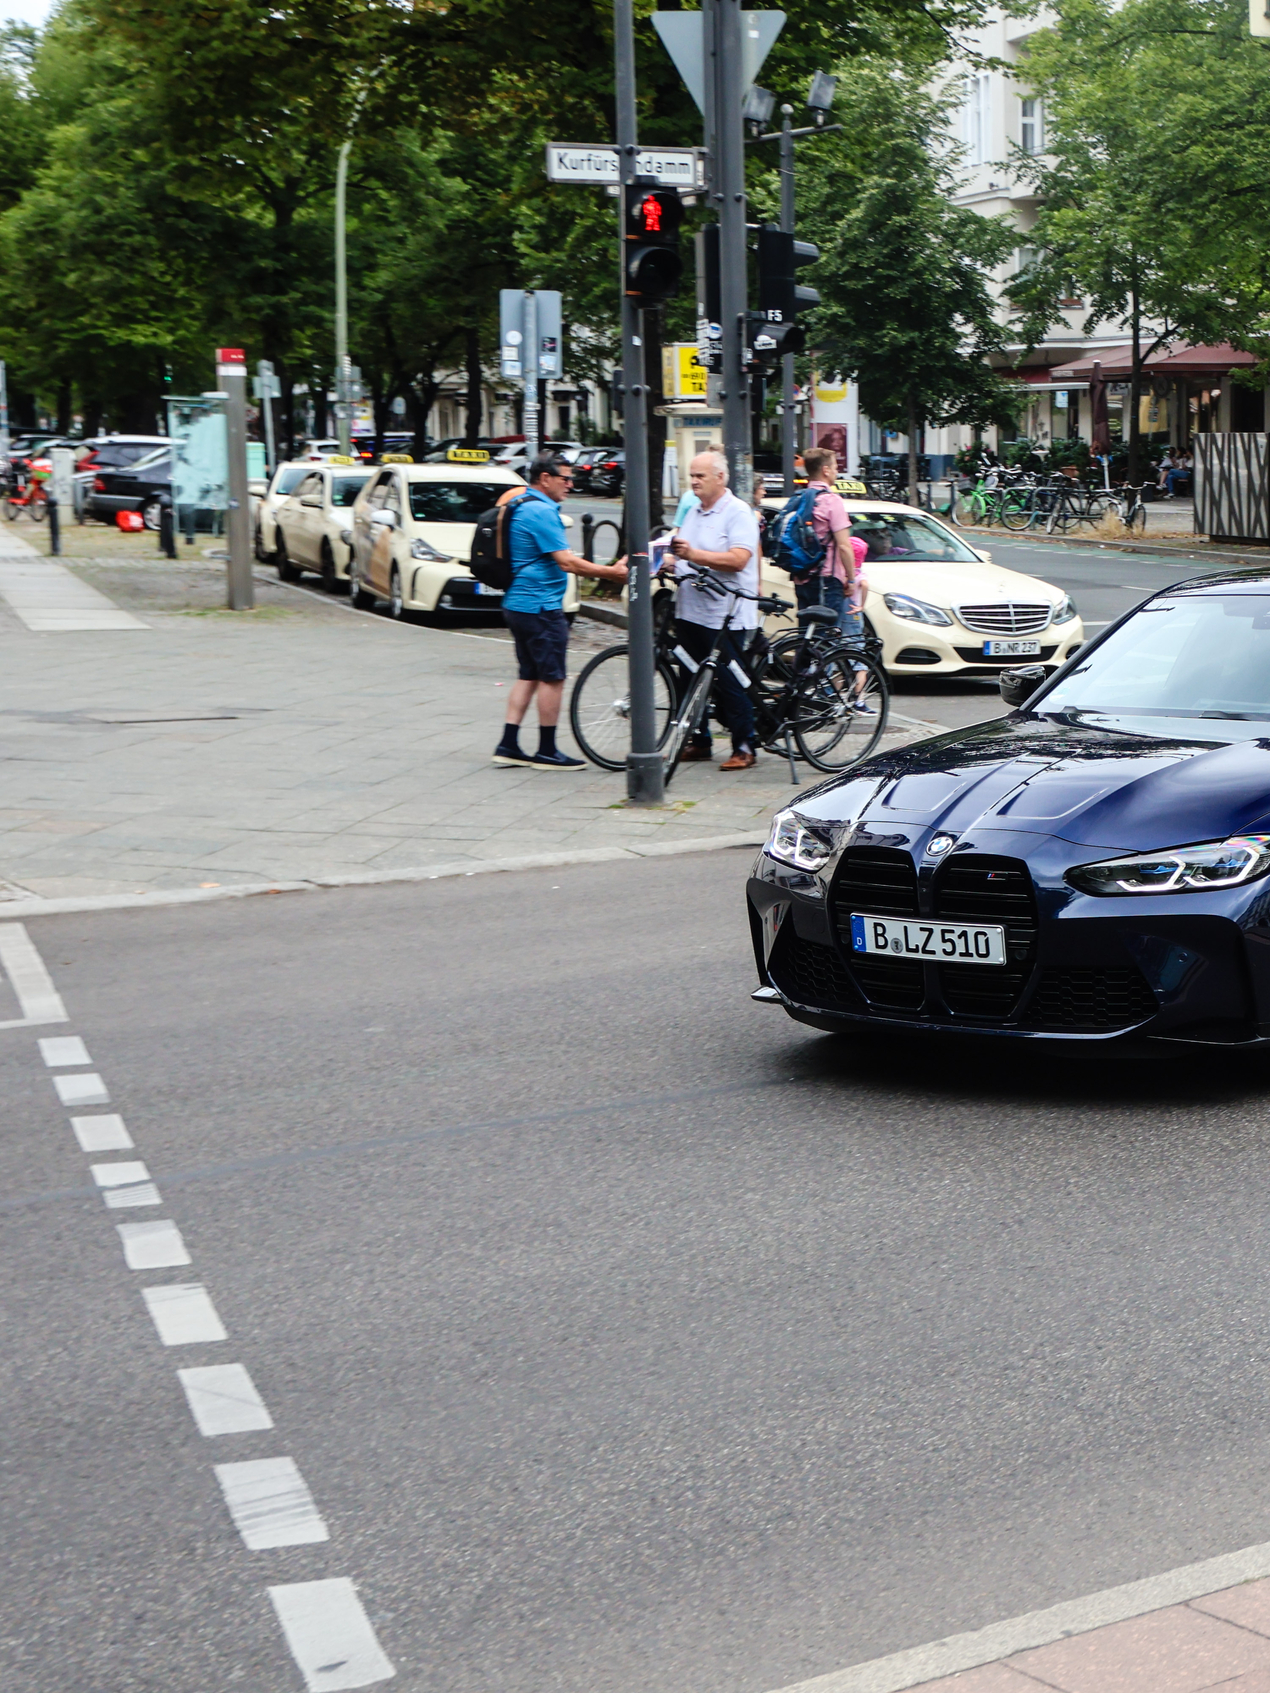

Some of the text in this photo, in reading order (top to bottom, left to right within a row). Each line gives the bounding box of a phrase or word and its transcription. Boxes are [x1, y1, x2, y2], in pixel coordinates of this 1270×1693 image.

[556, 151, 691, 175] Kurfürsndamm
[767, 309, 783, 322] F5
[836, 482, 862, 491] TAXI
[994, 643, 1001, 654] B
[873, 922, 888, 950] B
